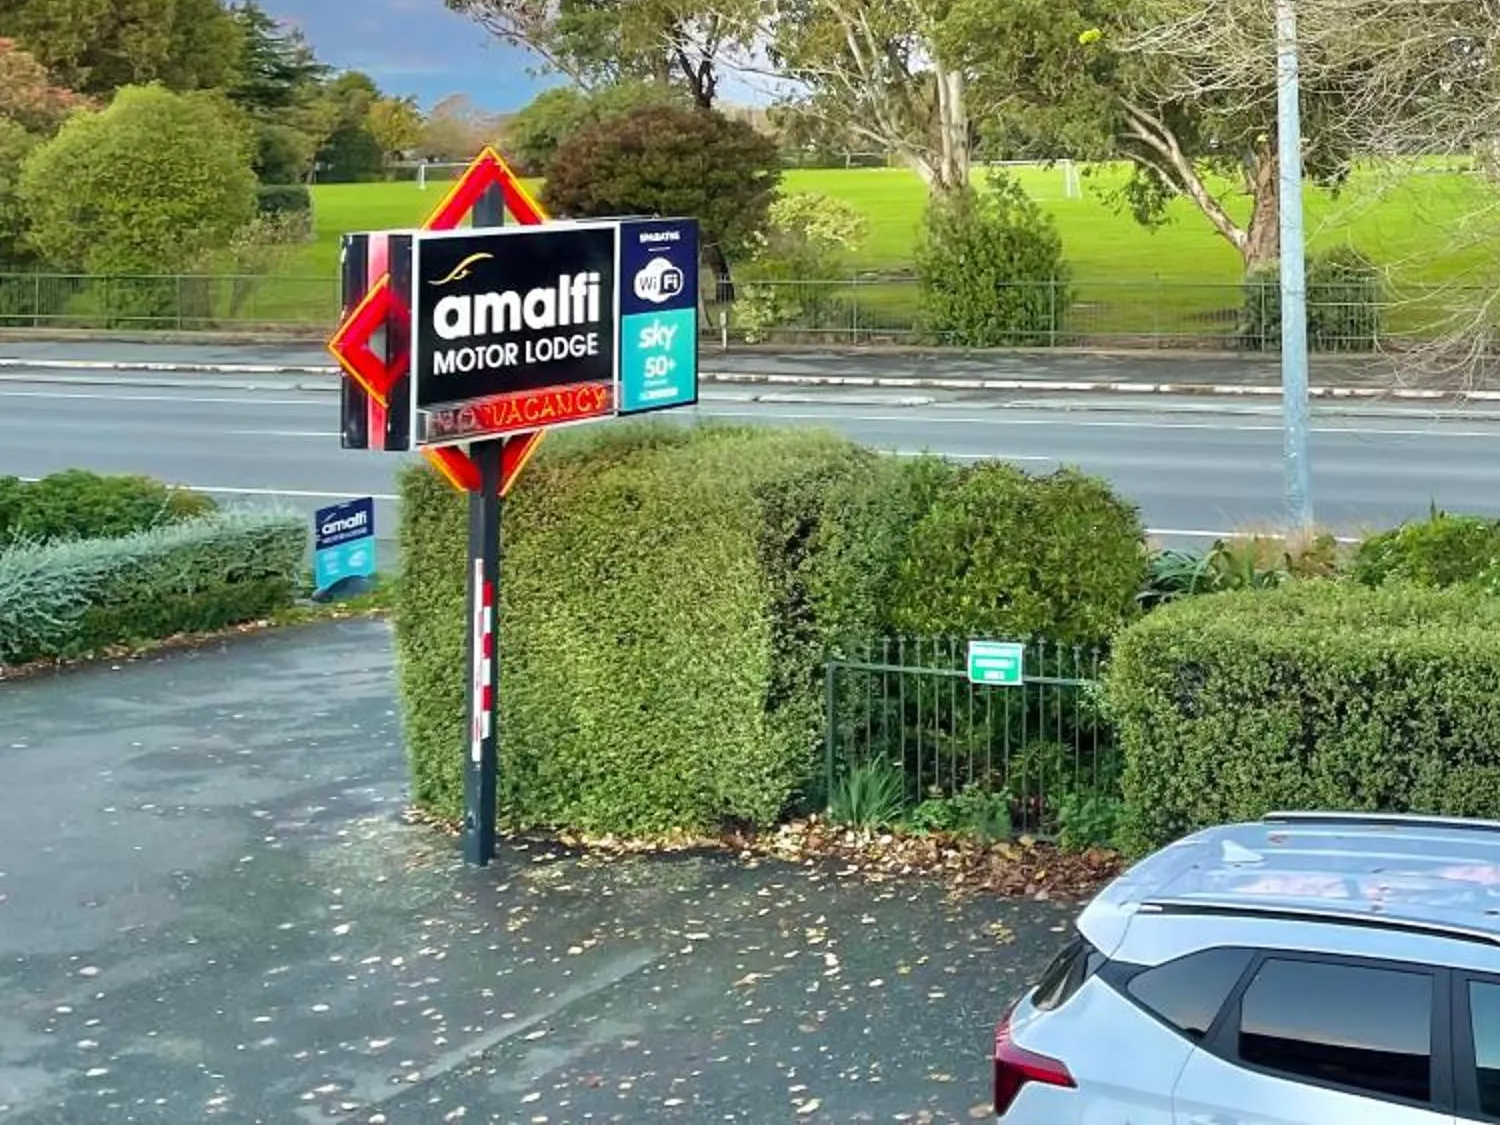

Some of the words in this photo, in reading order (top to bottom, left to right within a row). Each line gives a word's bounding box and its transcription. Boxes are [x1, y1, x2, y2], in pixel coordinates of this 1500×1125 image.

[433, 272, 600, 341] amalfi
[638, 318, 679, 351] sky
[433, 341, 519, 376] MOTOR
[525, 332, 599, 364] LODGE
[644, 355, 677, 379] 50+
[489, 385, 608, 426] VACANCY
[321, 510, 367, 534] amalfi
